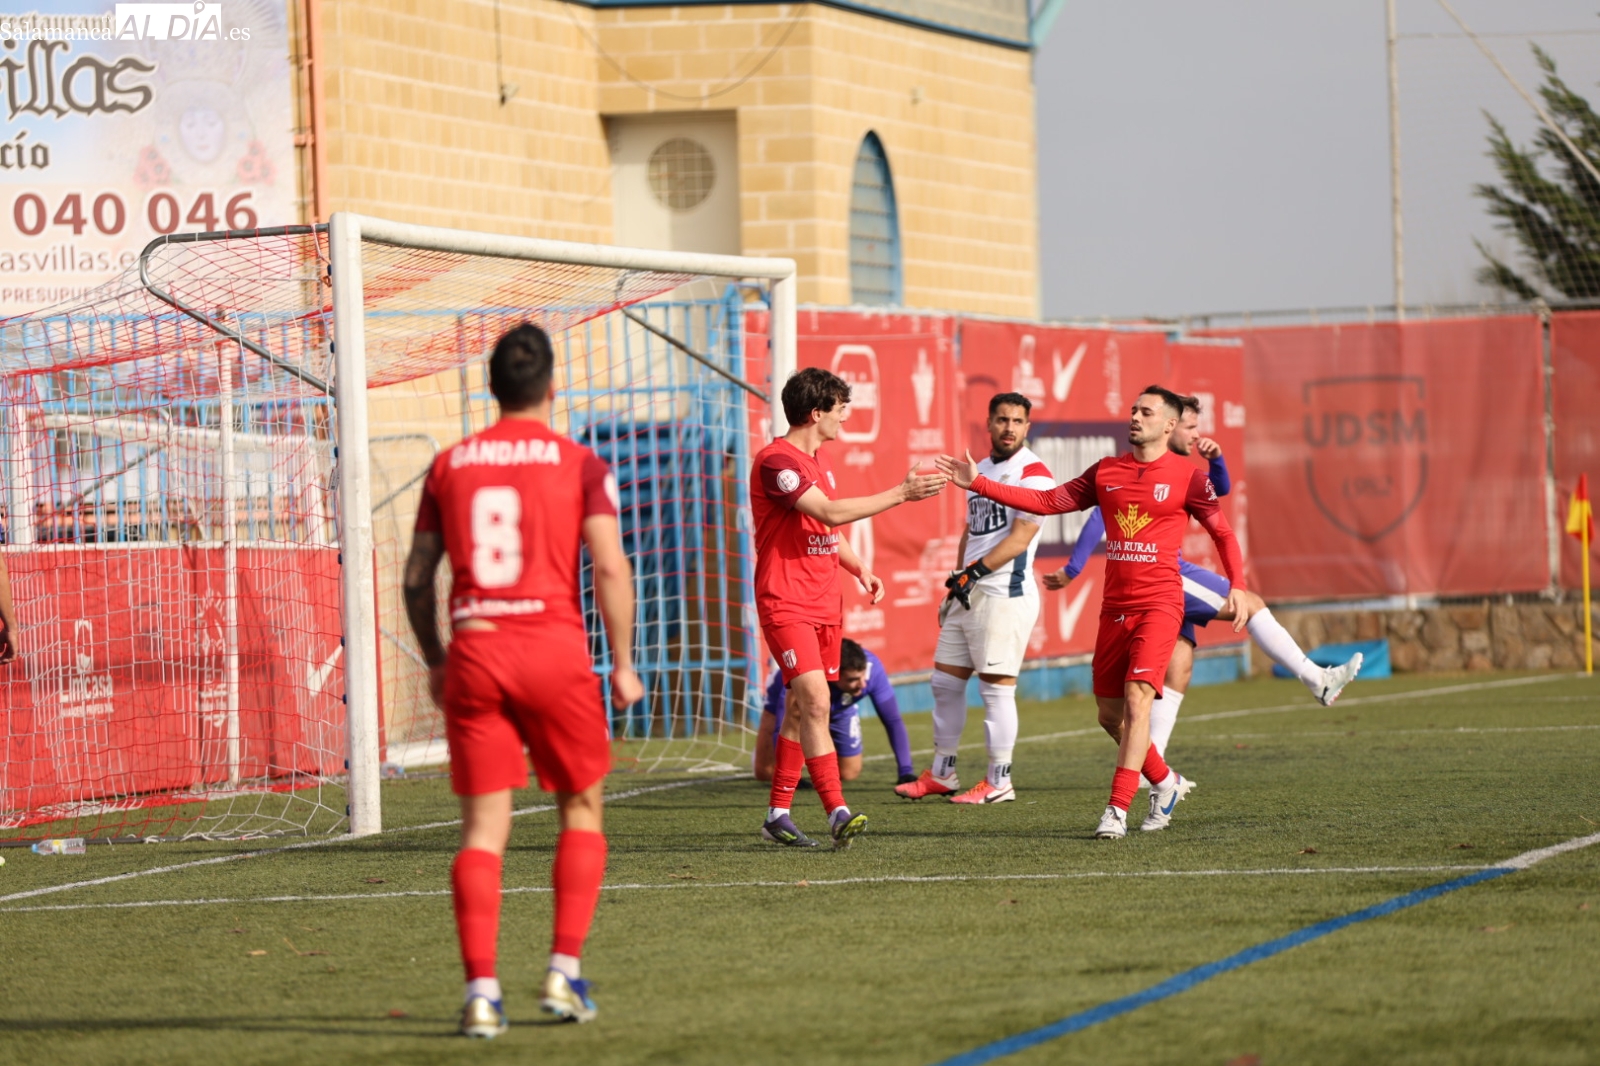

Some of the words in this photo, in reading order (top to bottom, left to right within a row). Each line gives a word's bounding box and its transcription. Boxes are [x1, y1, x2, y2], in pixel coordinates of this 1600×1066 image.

[0, 131, 49, 169] cío
[13, 193, 126, 235] 040
[148, 192, 258, 235] 046
[1, 245, 150, 271] asvillas.e
[1302, 409, 1427, 447] UDSM
[471, 485, 523, 589] 8
[1123, 541, 1158, 553] RURAL
